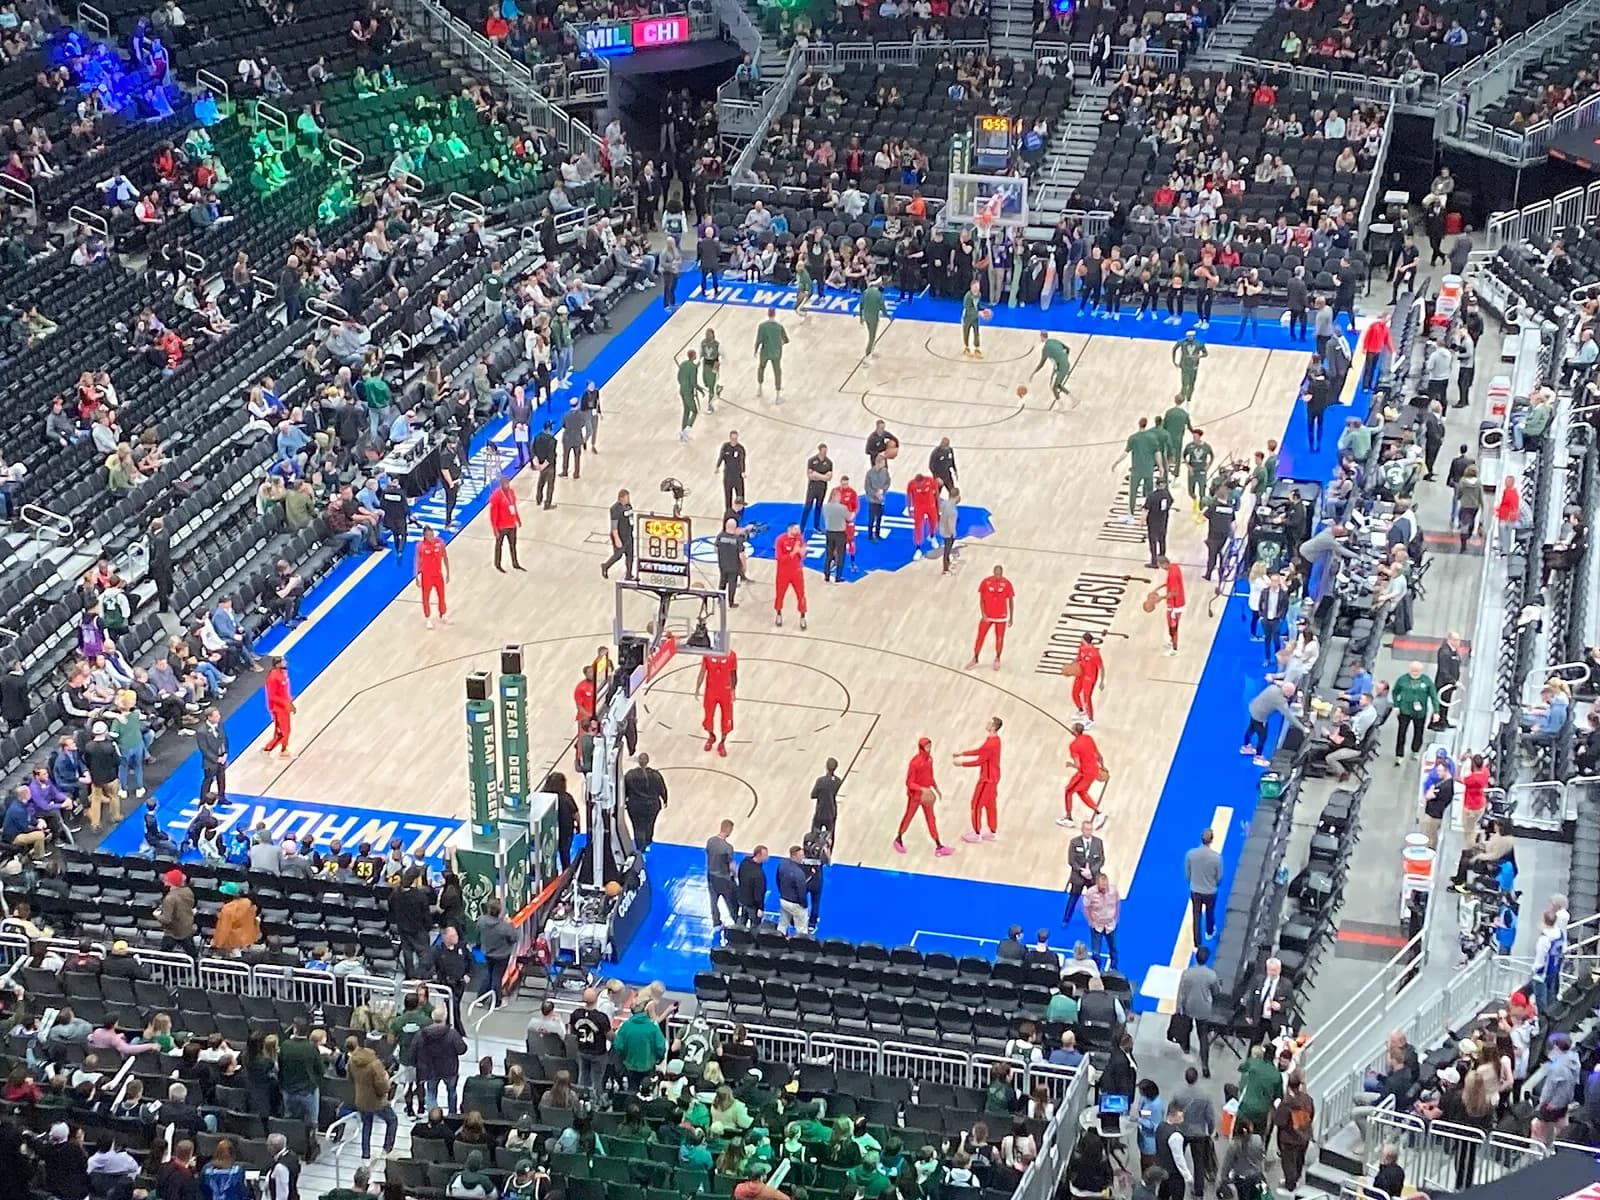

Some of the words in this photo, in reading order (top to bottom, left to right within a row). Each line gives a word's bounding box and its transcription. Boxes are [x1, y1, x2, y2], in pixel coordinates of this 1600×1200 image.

[586, 27, 626, 49] MIL
[644, 21, 680, 43] CHI
[982, 118, 1008, 131] 10:55
[646, 520, 684, 538] 10:55
[506, 701, 519, 739] FEAR
[483, 723, 495, 765] FEAR
[508, 755, 521, 794] DEER
[487, 780, 498, 821] DEER
[578, 1028, 595, 1044] 34
[683, 1043, 705, 1065] 34
